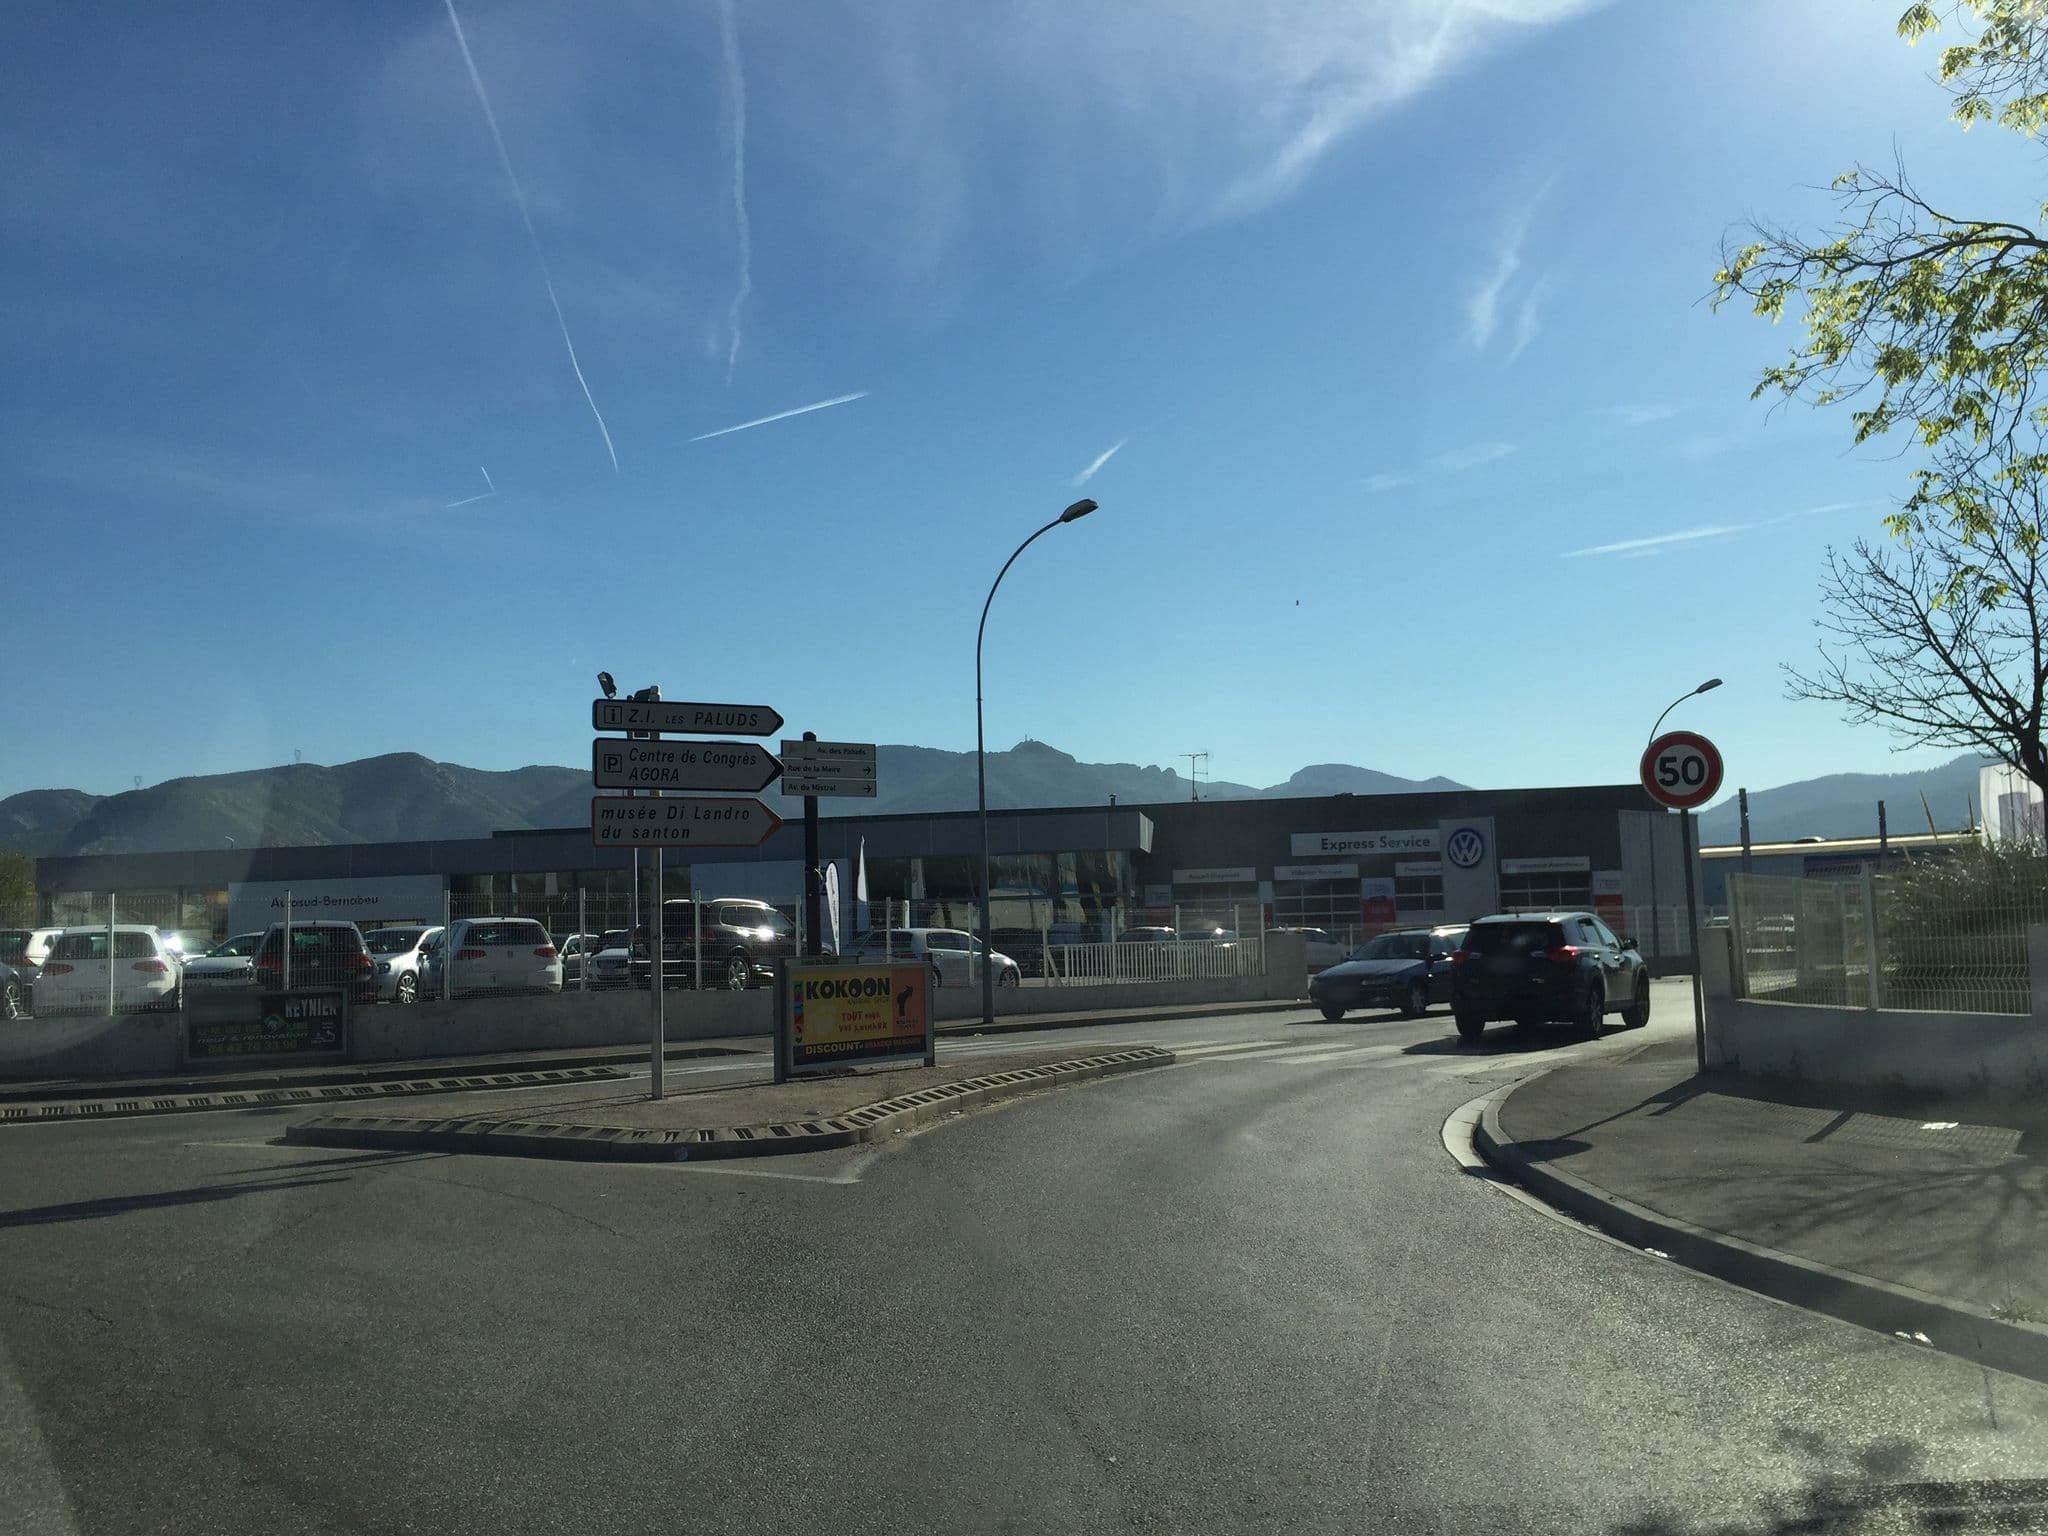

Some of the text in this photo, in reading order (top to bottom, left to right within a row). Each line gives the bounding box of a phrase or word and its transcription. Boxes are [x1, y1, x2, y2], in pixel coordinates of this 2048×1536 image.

[628, 709, 655, 723] Z.I.
[665, 715, 684, 725] LES
[694, 711, 759, 727] PALUDS
[629, 748, 757, 768] Centre de Congrès
[629, 768, 680, 782] AGORA
[1659, 756, 1705, 786] 50
[601, 806, 750, 821] musée Di Landro
[601, 825, 690, 839] du santon
[1321, 836, 1431, 852] Express Service
[270, 895, 379, 908] Auosud-Bernabeu
[806, 977, 891, 1000] KOKOON
[841, 1011, 864, 1022] TOUT
[805, 1041, 861, 1055] DISCOUNT
